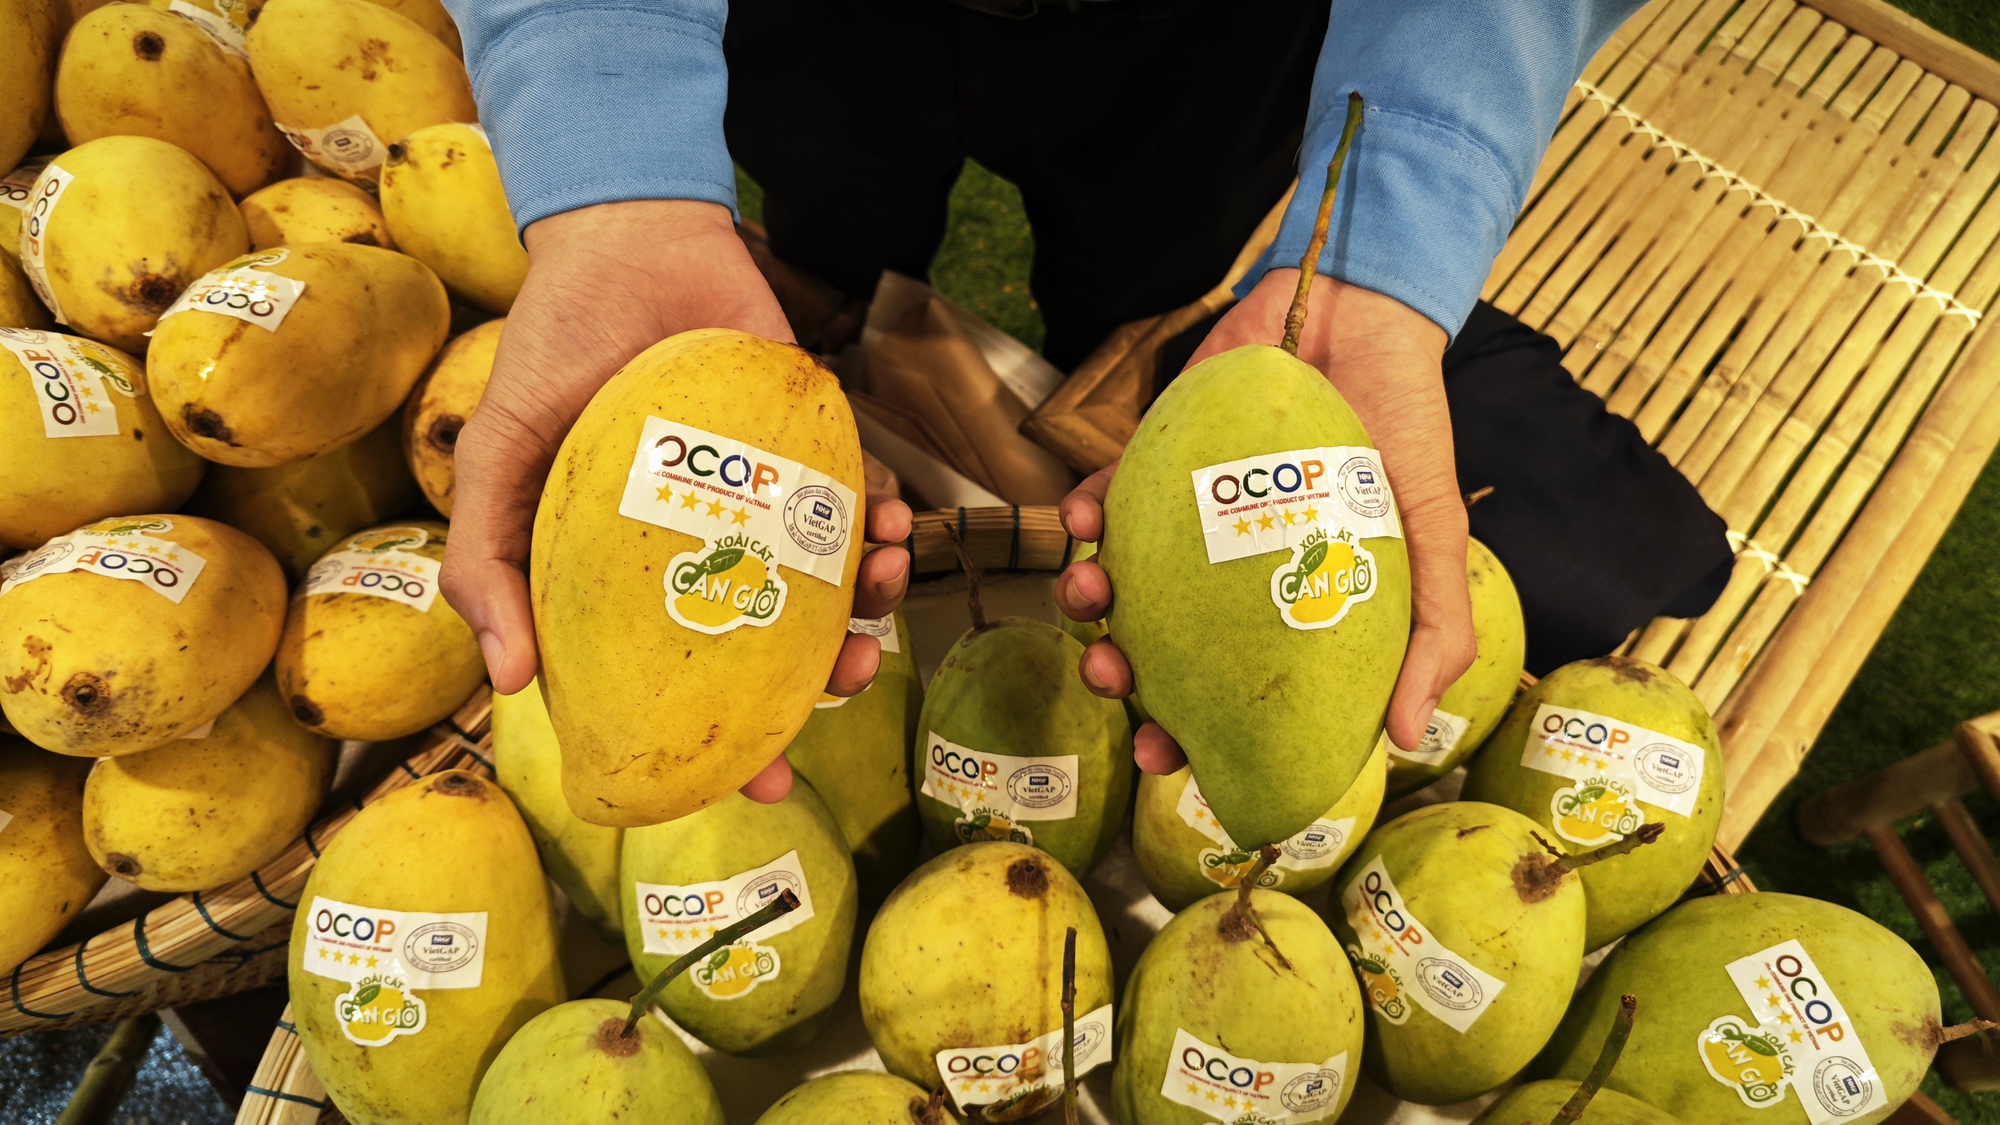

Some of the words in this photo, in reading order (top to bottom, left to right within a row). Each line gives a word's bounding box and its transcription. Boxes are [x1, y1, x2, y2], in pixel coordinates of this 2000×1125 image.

[29, 178, 60, 257] OCOP
[22, 349, 77, 425] OCOP
[654, 435, 779, 495] OCOP
[662, 470, 693, 486] COMMUNE
[693, 480, 707, 490] ONE
[707, 485, 736, 498] PRODUCT
[736, 493, 745, 501] OF
[1211, 459, 1325, 505] OCOP
[1355, 486, 1381, 495] VietGAP
[1230, 503, 1259, 514] COMMUNE
[1272, 497, 1298, 506] PRODUCT
[1307, 492, 1330, 500] VIETNAM
[804, 513, 836, 534] VietGAP
[806, 530, 827, 542] certified
[713, 532, 749, 551] XOÀI
[750, 540, 774, 562] CÁT
[1299, 527, 1327, 552] XOÀI
[1330, 527, 1353, 543] ÁT
[77, 551, 178, 587] OCOP
[342, 571, 424, 598] OCOP
[1543, 713, 1630, 749] OCOP
[932, 745, 998, 781] OCOP
[1651, 763, 1684, 779] VietGAP
[1582, 777, 1608, 788] XOÀI
[1609, 780, 1630, 797] CÁT
[971, 805, 991, 815] XOÀI
[1296, 839, 1327, 848] VietGAP
[645, 890, 725, 917] OCOP
[1365, 871, 1423, 945] OCOP
[316, 909, 396, 944] OCOP
[423, 946, 460, 954] VietGAP
[357, 972, 382, 989] XOÀI
[384, 975, 404, 989] CÁT
[1368, 952, 1389, 969] XOÀI
[1389, 968, 1404, 987] CÁT
[1775, 954, 1844, 1042] OCOP
[1790, 1001, 1805, 1023] PRODUCT
[1806, 1029, 1820, 1051] VIETNAM
[947, 1046, 1039, 1074] OCOP
[1760, 1031, 1788, 1055] XOÀI
[1782, 1055, 1796, 1077] CÁT
[1182, 1047, 1275, 1092] OCOP
[1831, 1074, 1850, 1104] VietGAP
